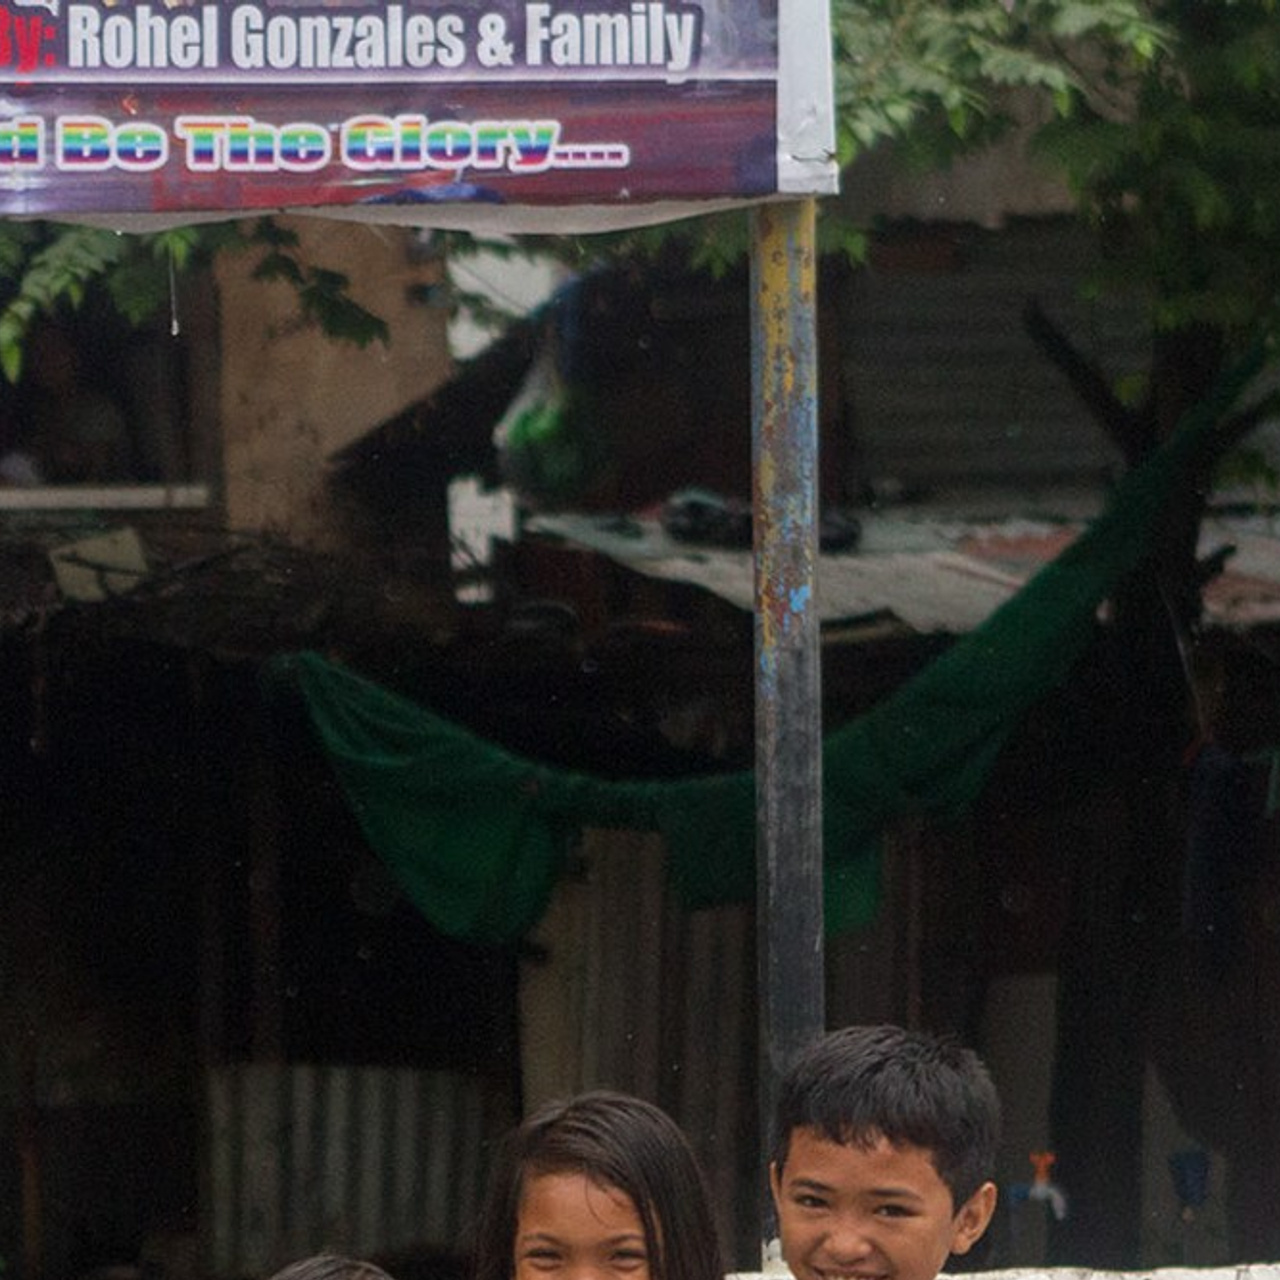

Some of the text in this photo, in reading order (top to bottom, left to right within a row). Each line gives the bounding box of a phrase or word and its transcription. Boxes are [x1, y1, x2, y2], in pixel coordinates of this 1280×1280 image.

[68, 5, 218, 68] Rohel
[230, 5, 465, 69] Gonzales
[476, 13, 514, 66] &
[526, 3, 695, 84] Family
[55, 116, 168, 171] Be
[174, 116, 330, 171] The
